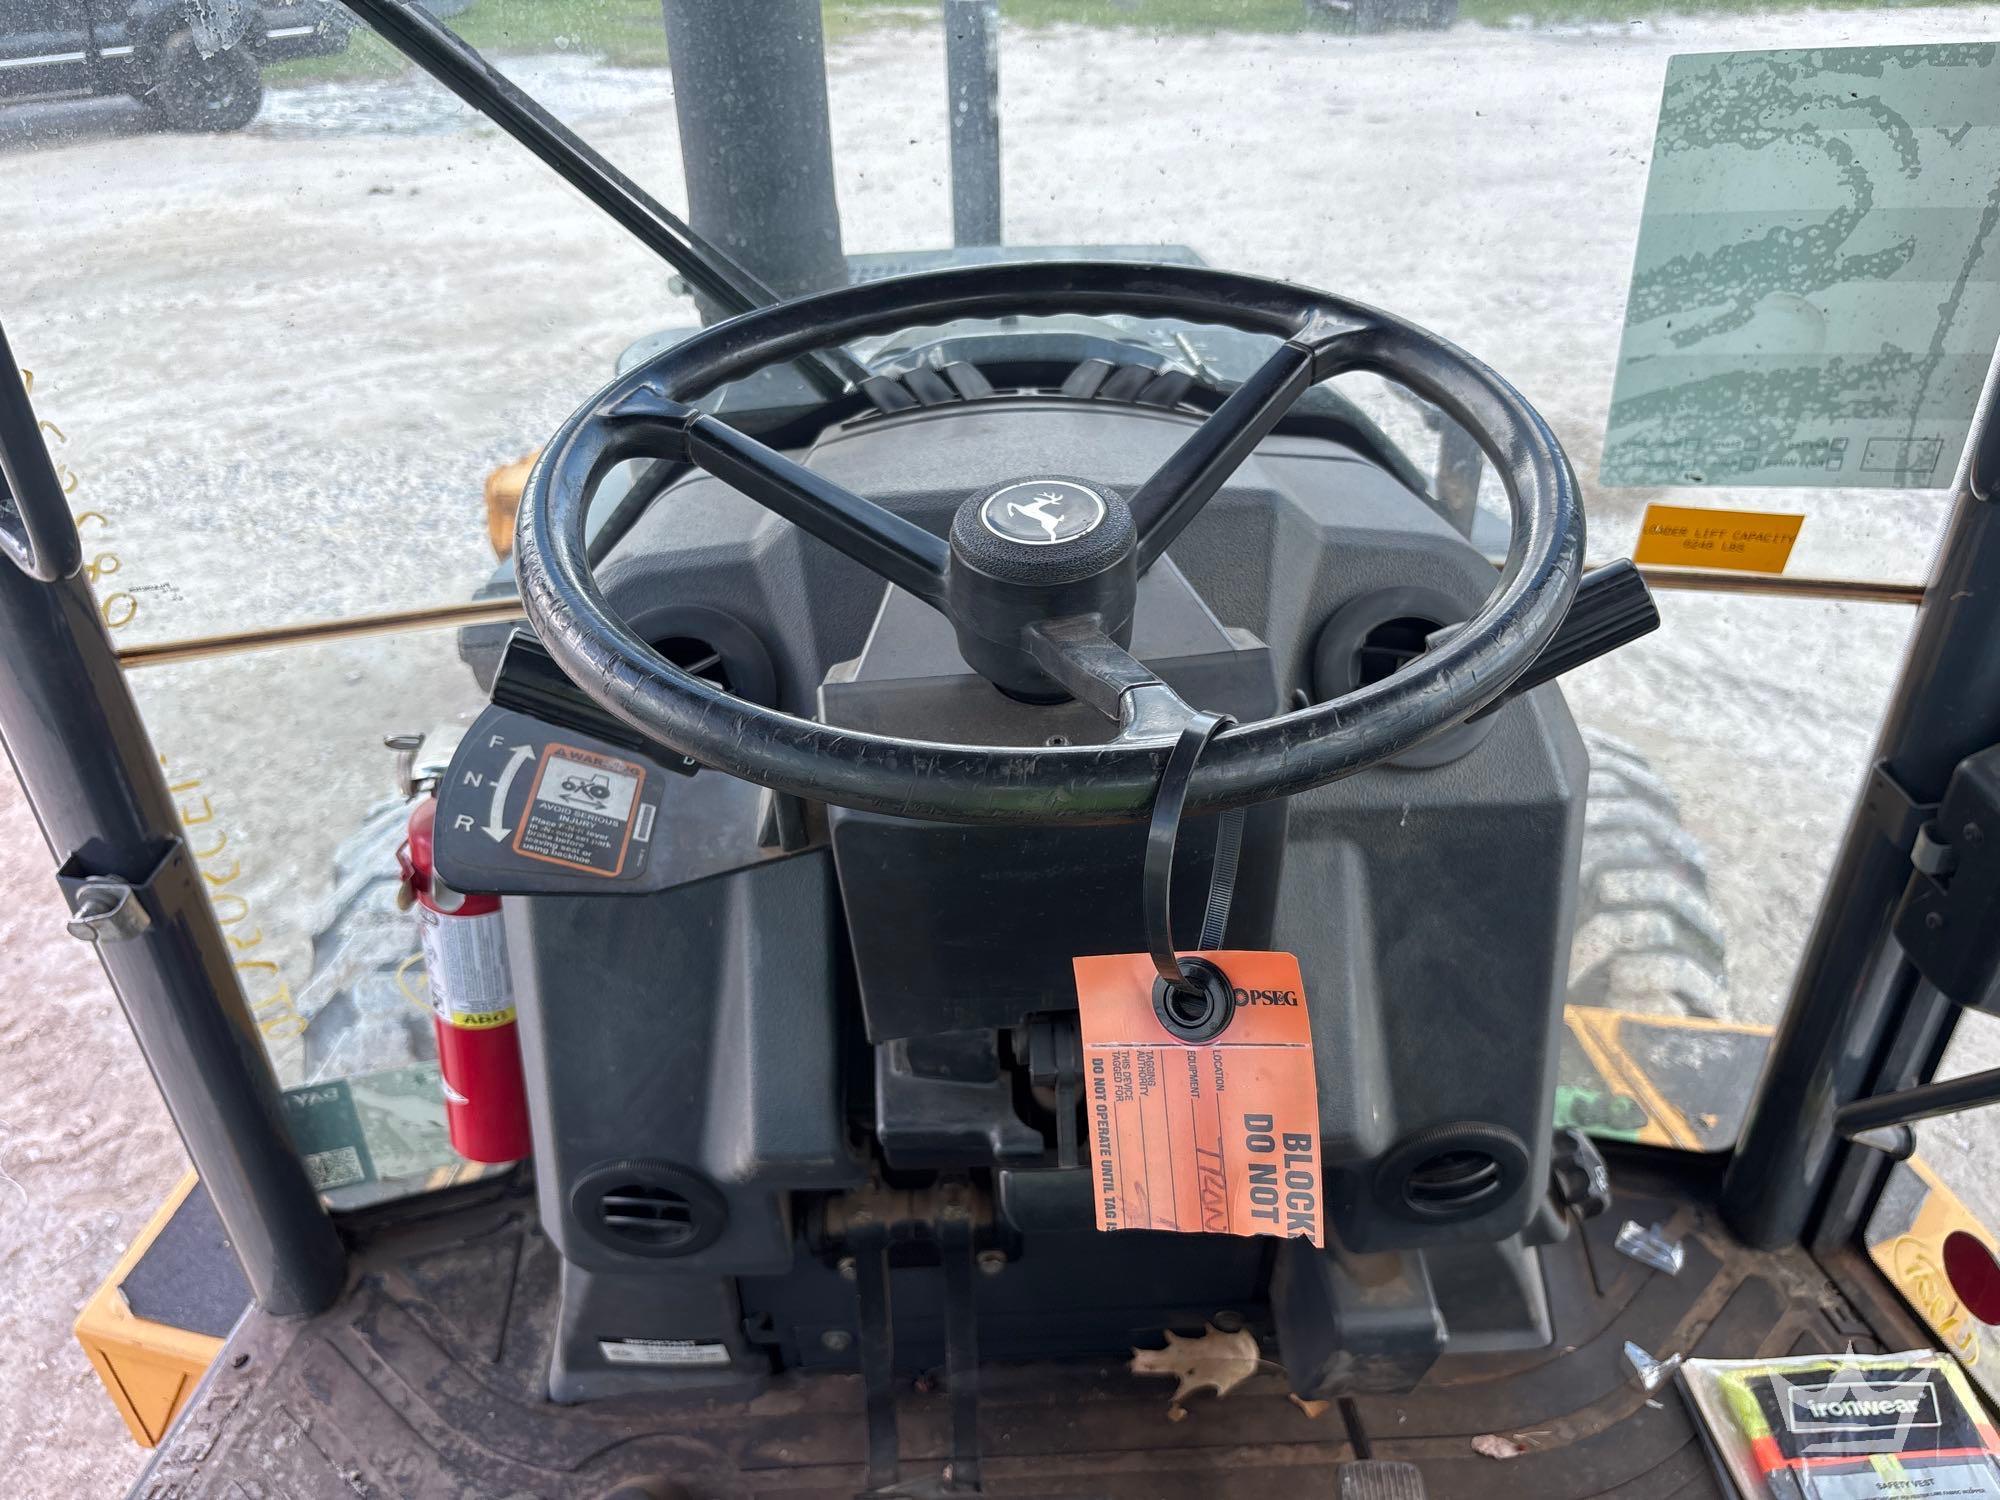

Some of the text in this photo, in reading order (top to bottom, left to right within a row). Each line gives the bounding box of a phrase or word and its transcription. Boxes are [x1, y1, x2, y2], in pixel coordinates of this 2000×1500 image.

[489, 735, 504, 748] F
[464, 771, 483, 788] N
[454, 814, 475, 832] R
[540, 802, 619, 827] AVOID SERIOUS
[560, 814, 597, 829] INJURY
[527, 829, 585, 848] brake before
[531, 815, 556, 827] Place
[586, 831, 608, 840] lever
[522, 843, 549, 854] using
[525, 836, 559, 850] leaving
[1092, 1058, 1104, 1074] DO
[1112, 1051, 1124, 1102] TAGGED FOR
[1121, 1051, 1133, 1101] THIS DEVICE
[1137, 1050, 1148, 1096] AUTHORITY
[1146, 1050, 1157, 1087] TAGGING
[1187, 1050, 1200, 1098] EQUIPMENT
[1213, 1050, 1224, 1091] LOCATION
[1094, 1078, 1106, 1101] NOT
[1096, 1104, 1111, 1156] OPERATE
[1101, 1160, 1115, 1193] UNTIL
[1244, 1114, 1279, 1224] DO NOT
[1104, 1197, 1117, 1219] TAG
[1807, 1399, 1919, 1418] ironwear
[1876, 1478, 1935, 1490] SAFETY VEST
